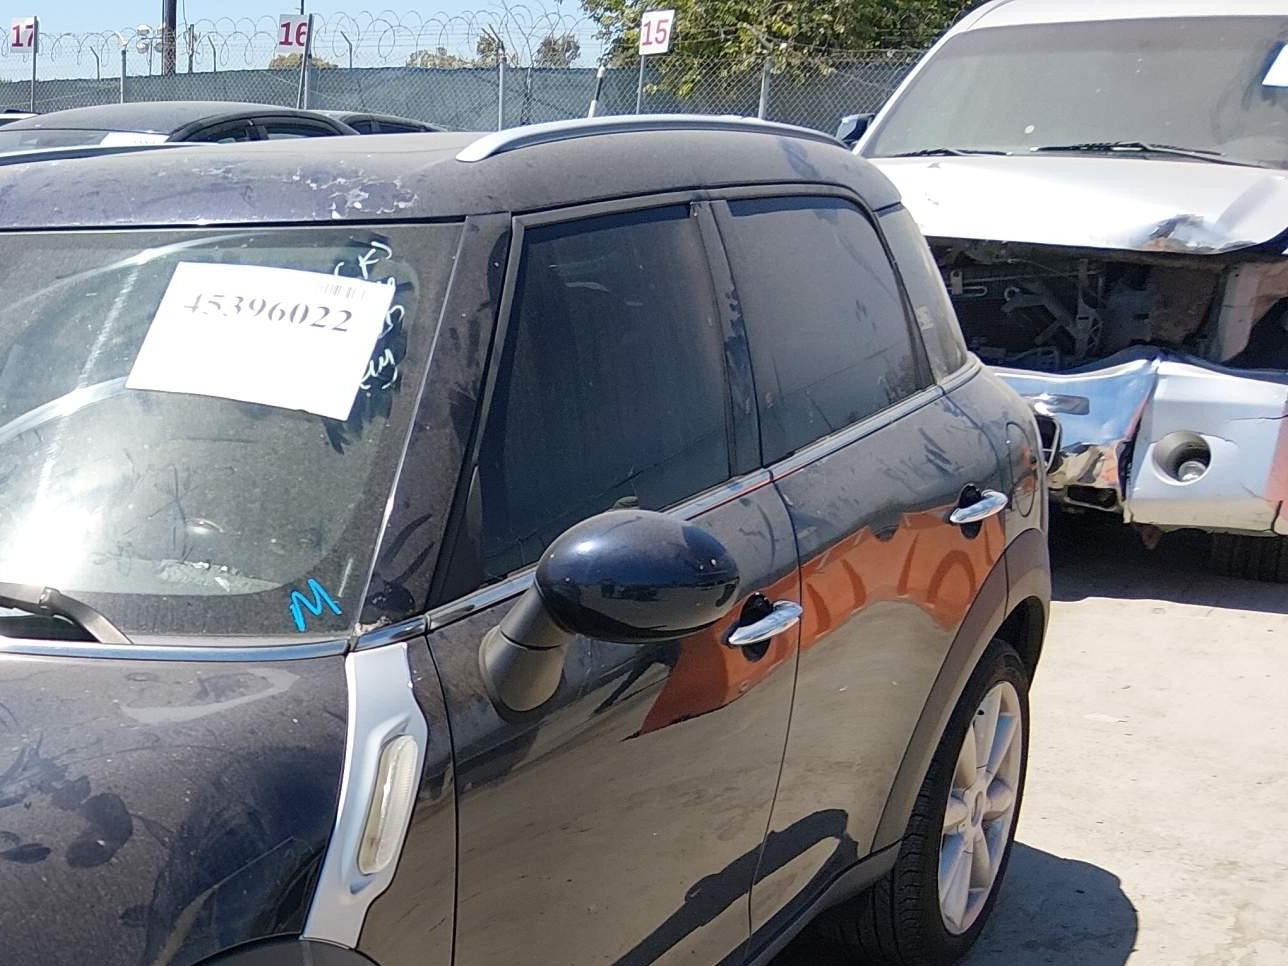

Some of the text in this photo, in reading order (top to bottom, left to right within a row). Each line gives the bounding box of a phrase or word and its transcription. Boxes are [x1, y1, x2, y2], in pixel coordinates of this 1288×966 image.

[12, 24, 34, 47] 17
[279, 21, 308, 47] 16
[642, 19, 669, 46] 15
[183, 292, 353, 333] 45396022
[289, 578, 343, 633] M
